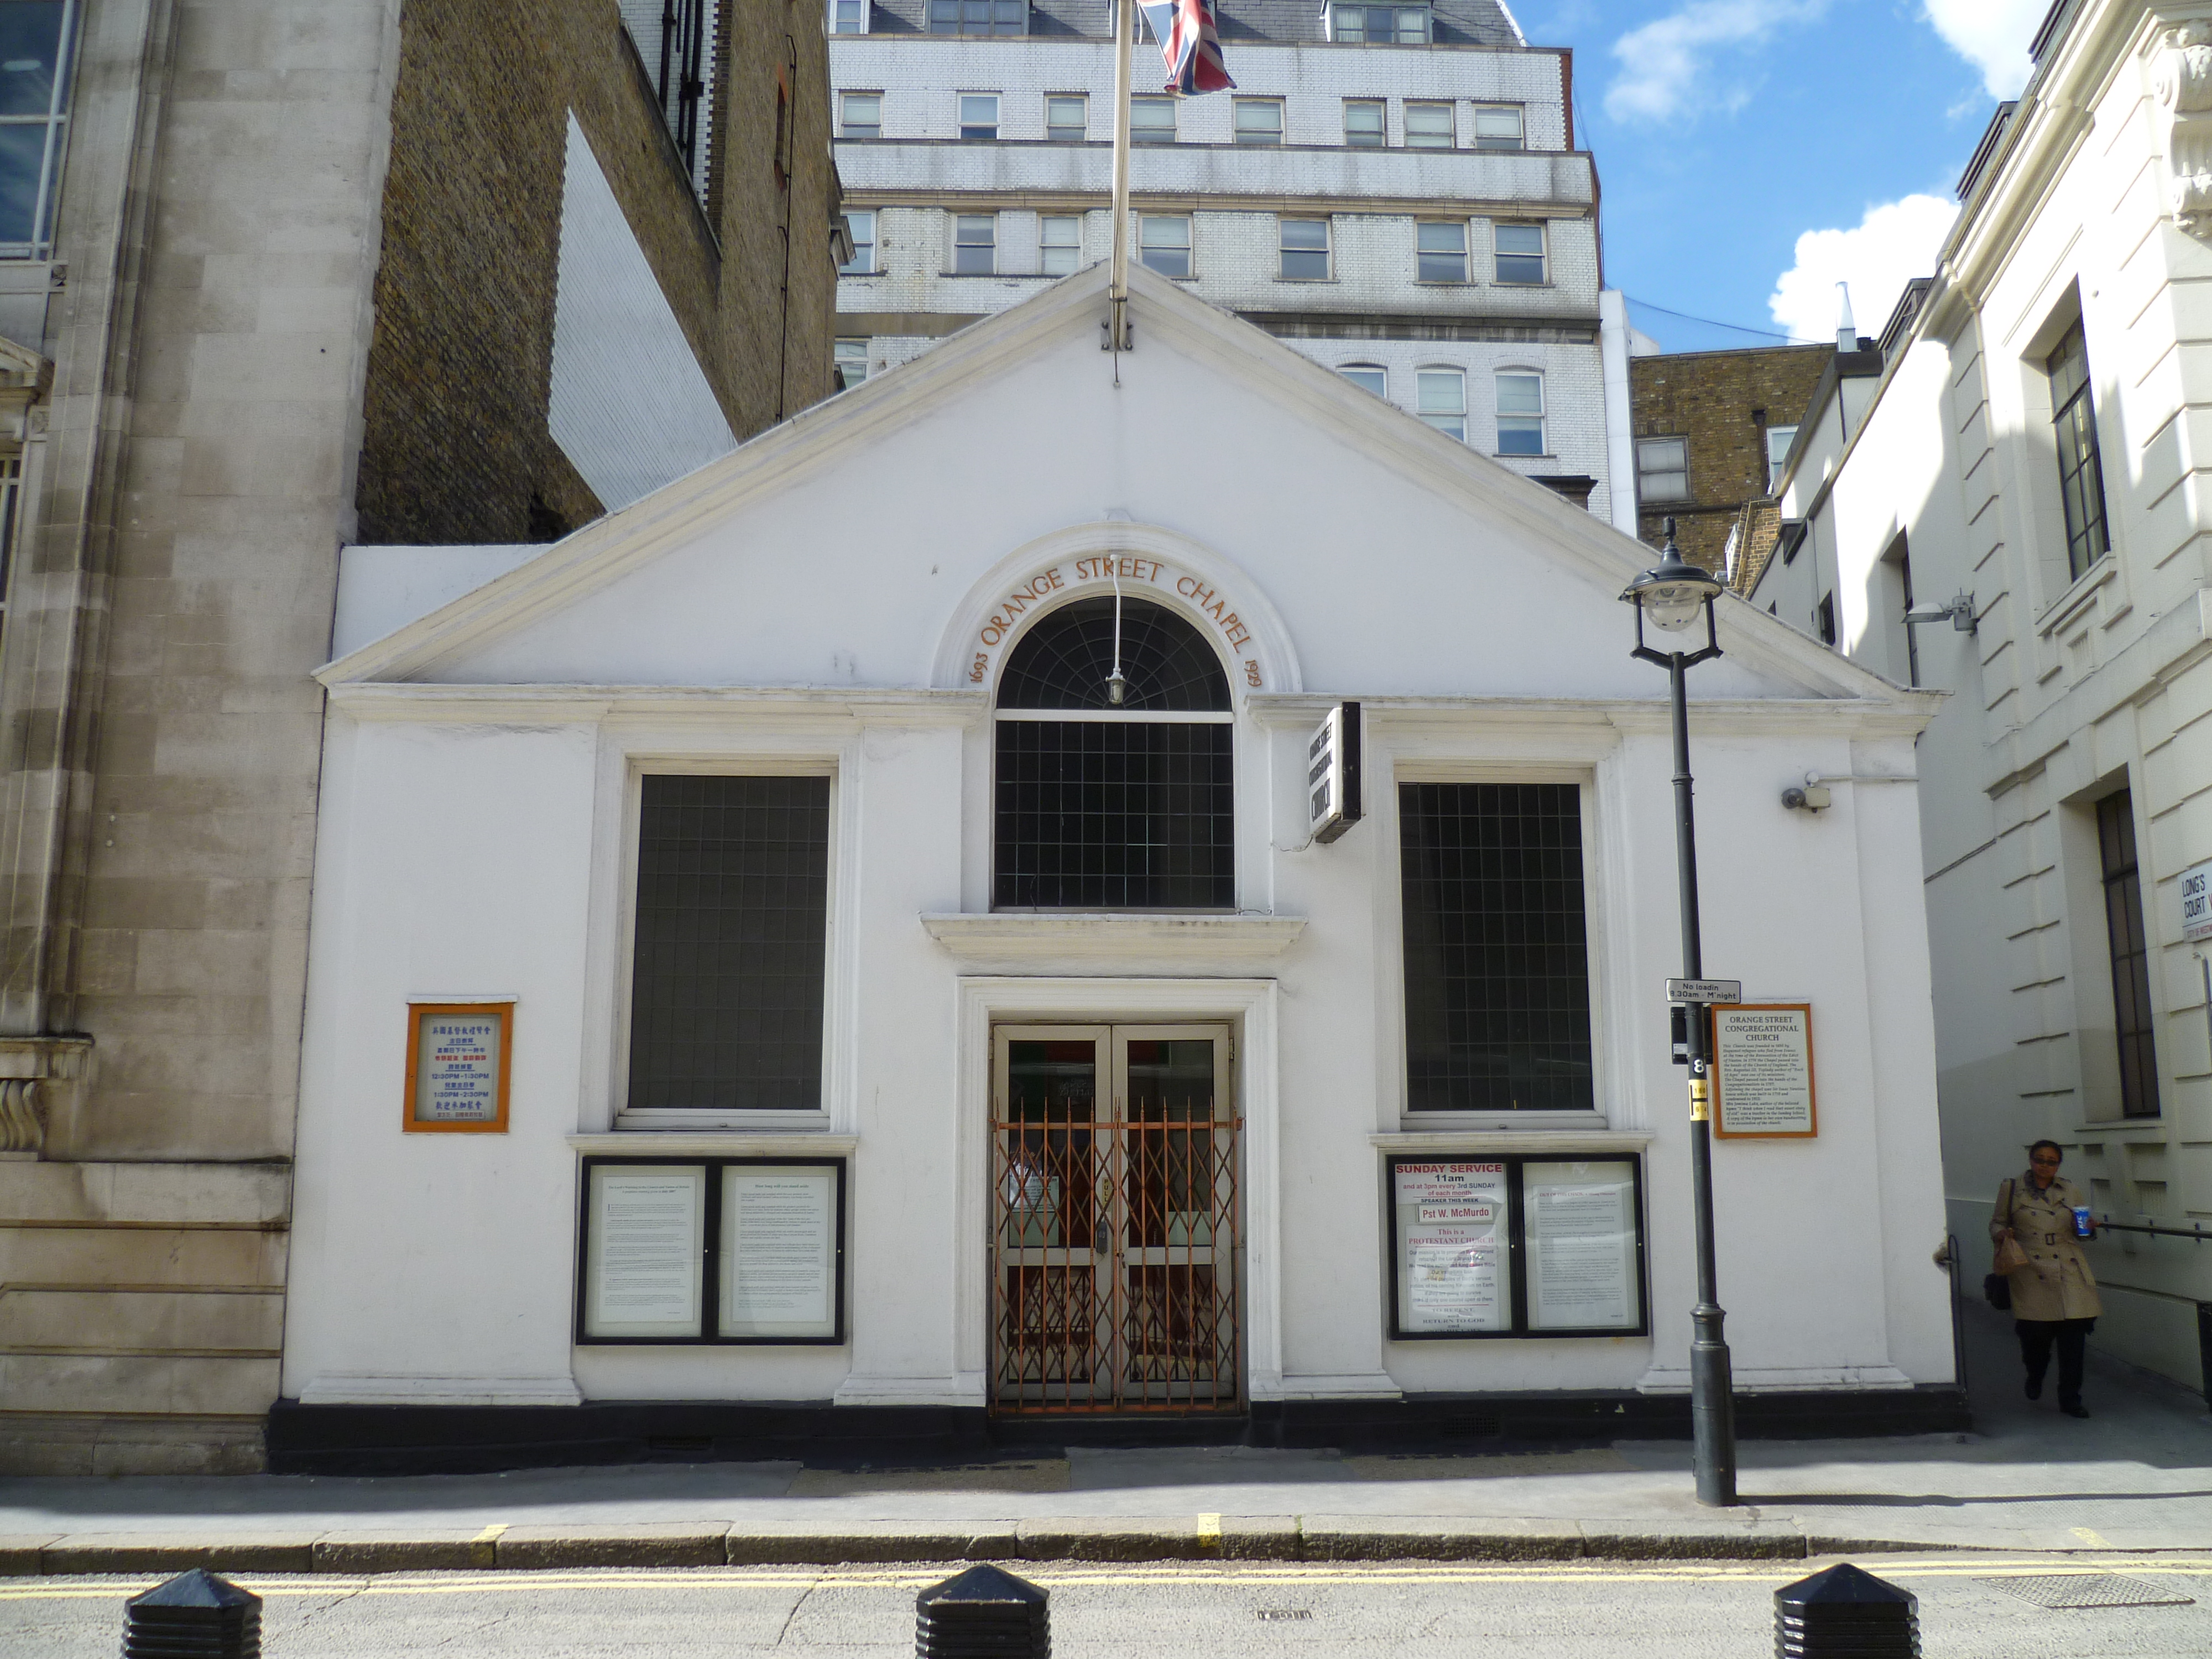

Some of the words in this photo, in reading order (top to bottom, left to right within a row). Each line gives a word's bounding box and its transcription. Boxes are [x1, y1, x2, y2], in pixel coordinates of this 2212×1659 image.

[969, 653, 988, 683] 1693
[981, 568, 1065, 646] ORANGE
[1076, 557, 1164, 582] STREET
[1177, 577, 1250, 654] CHAPEL
[1244, 660, 1262, 687] 1929
[1311, 778, 1331, 822] CHURCH
[2182, 874, 2205, 897] LONG'S
[2184, 896, 2205, 919] COURT
[1694, 1059, 1704, 1073] 8
[1422, 1209, 1436, 1218] Pst
[1437, 1209, 1448, 1218] W.
[1451, 1208, 1489, 1217] McMurdo
